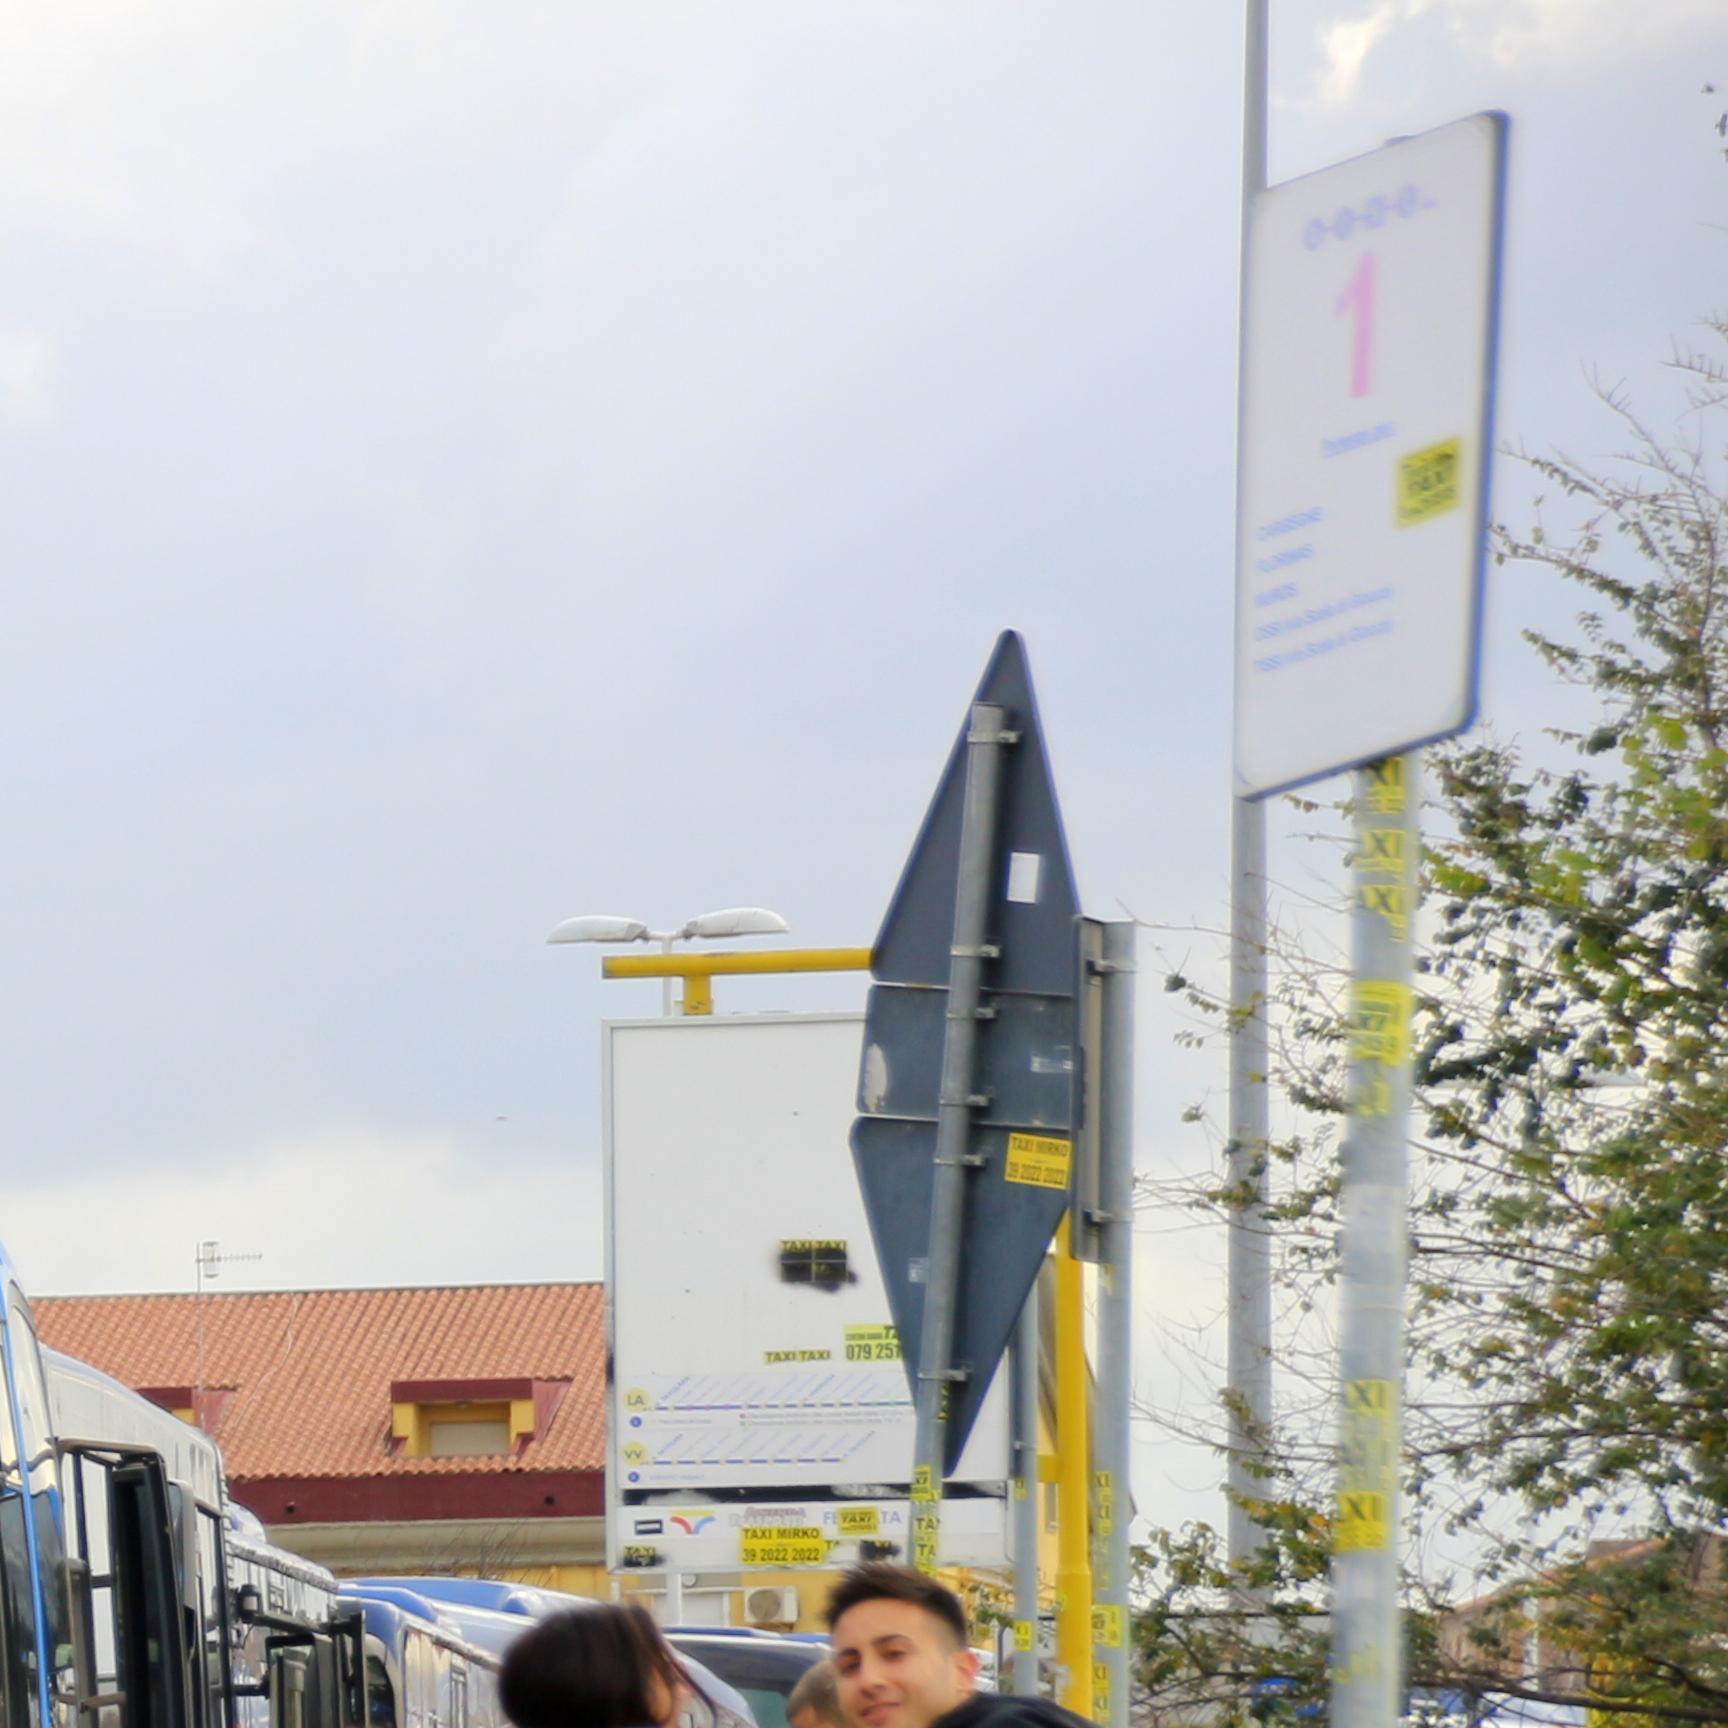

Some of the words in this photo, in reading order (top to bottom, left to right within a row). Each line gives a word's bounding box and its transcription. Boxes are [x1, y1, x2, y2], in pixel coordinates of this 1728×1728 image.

[1334, 250, 1376, 398] 1
[766, 1352, 795, 1363] TAXI
[800, 1351, 831, 1362] TAXI
[846, 1344, 872, 1361] 079
[627, 1394, 645, 1406] LA
[743, 1528, 772, 1540] TAXI
[776, 1528, 820, 1540] MIRKO
[743, 1549, 757, 1562] 39
[760, 1549, 789, 1562] 2022
[792, 1548, 821, 1561] 2022
